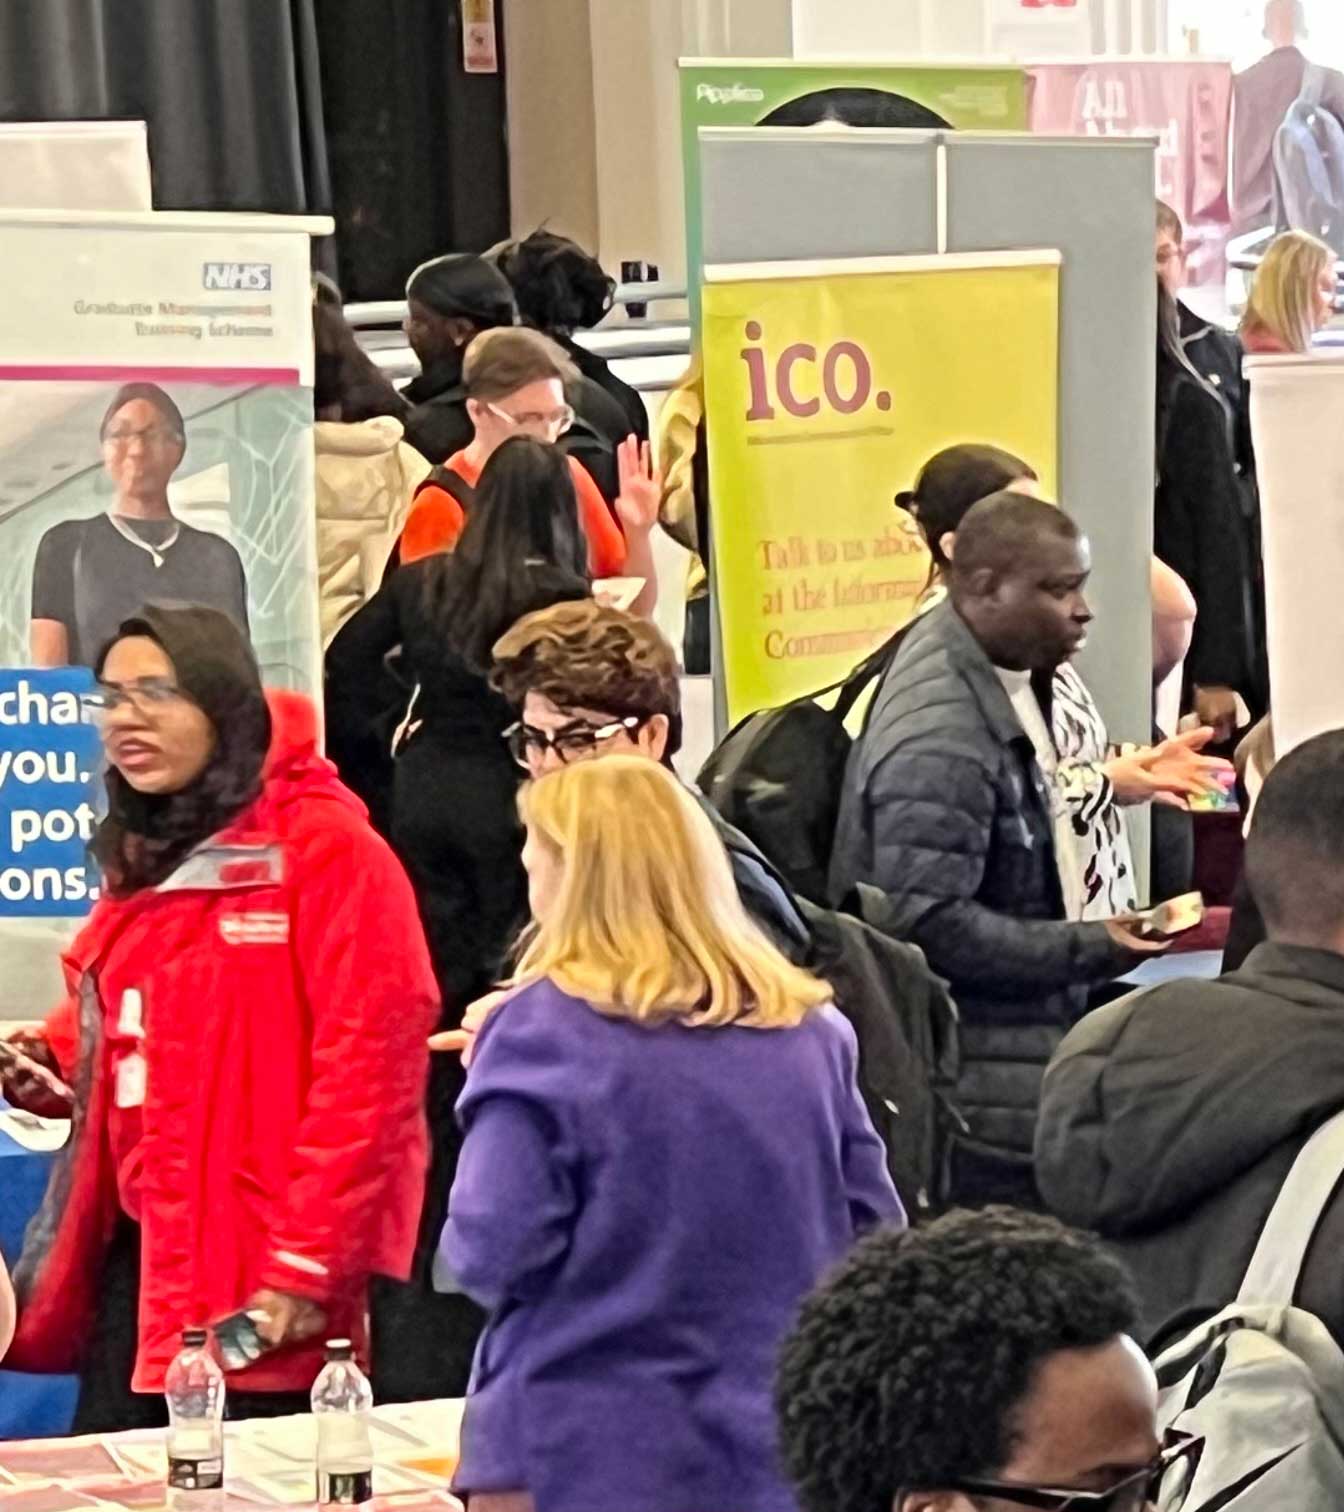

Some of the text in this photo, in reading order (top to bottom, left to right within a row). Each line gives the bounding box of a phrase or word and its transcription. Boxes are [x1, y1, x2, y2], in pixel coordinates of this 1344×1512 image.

[205, 264, 270, 289] NHS
[740, 320, 893, 422] ico.
[761, 588, 783, 616] at
